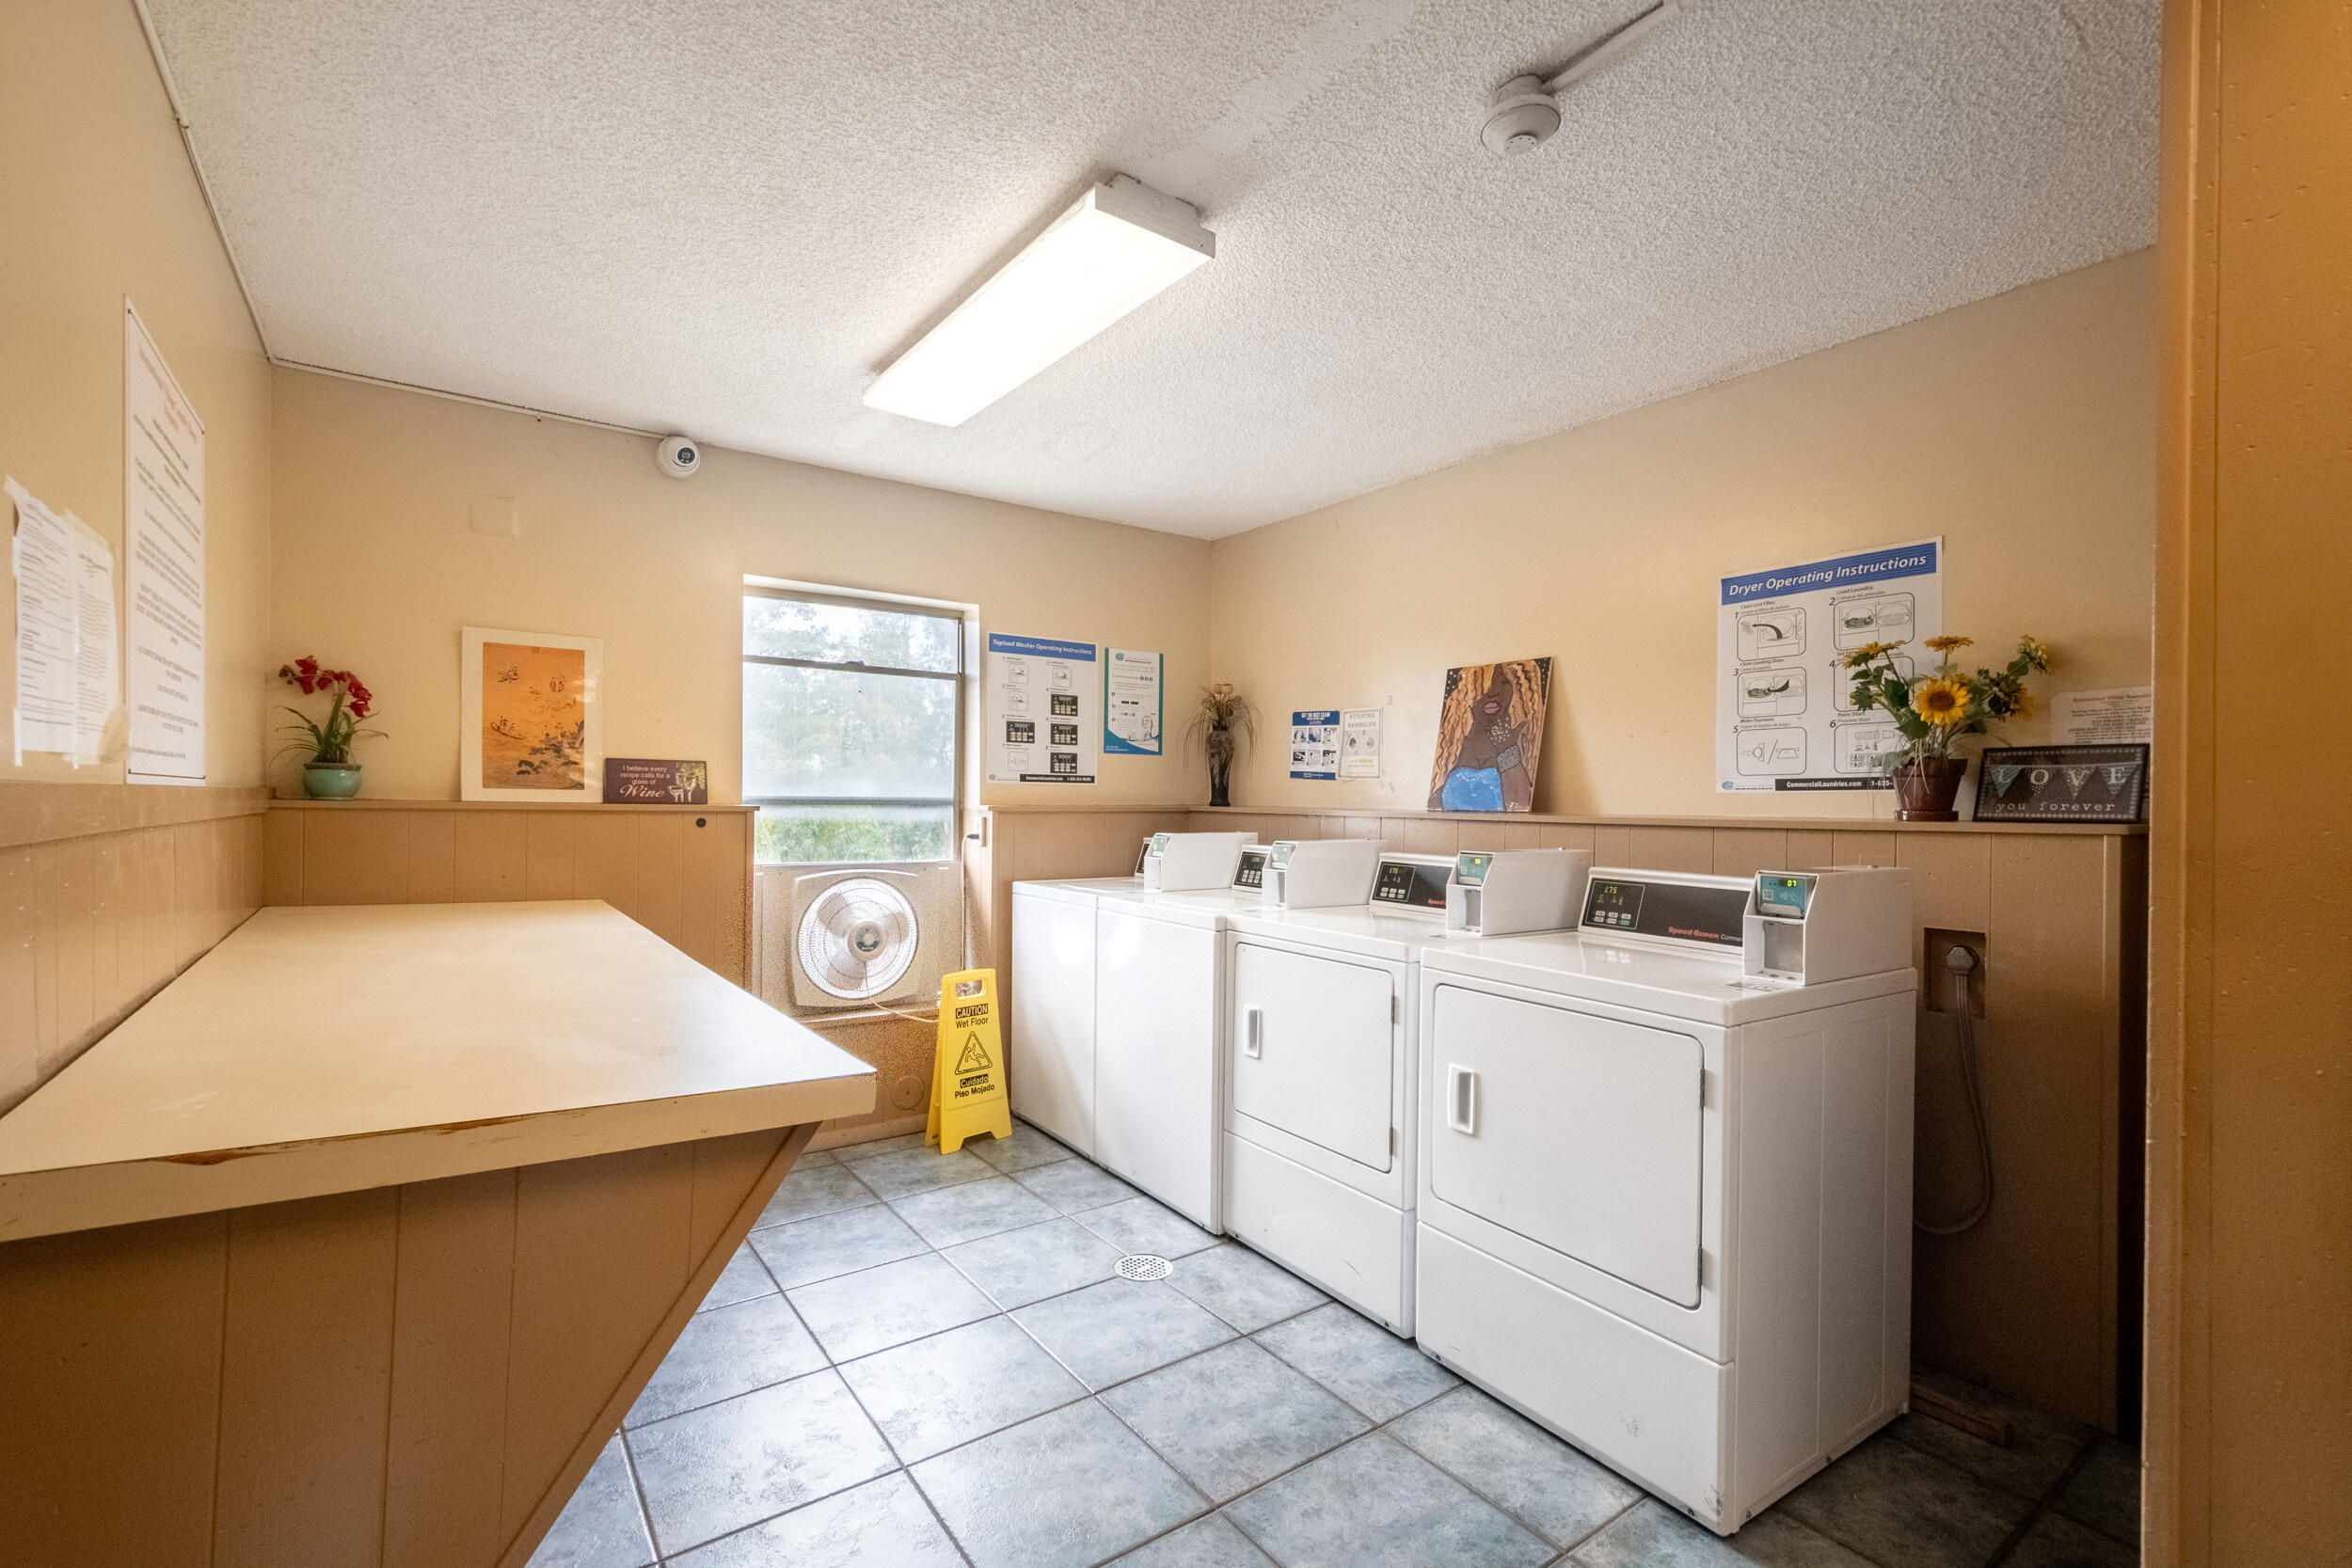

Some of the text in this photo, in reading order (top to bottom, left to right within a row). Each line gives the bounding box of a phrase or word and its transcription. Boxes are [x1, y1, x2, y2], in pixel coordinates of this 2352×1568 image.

[1729, 554, 1927, 596] Dryer Operating Instructions
[1829, 596, 1836, 606] 2
[1735, 611, 1739, 620] 1
[1036, 643, 1063, 653] Operating
[1063, 646, 1092, 655] Instructions
[1829, 659, 1836, 668] 4
[1733, 668, 1739, 676] 3
[1830, 719, 1836, 728] 6
[1733, 725, 1739, 734] 5
[1787, 780, 1862, 788] CommercialLaundries.com
[619, 784, 665, 798] Wine
[1995, 801, 2116, 813] you forever
[1668, 927, 1693, 936] Speed
[1693, 929, 1720, 939] Queen
[956, 1004, 988, 1019] CAUTION
[956, 1017, 989, 1028] Wet Floor
[961, 1075, 989, 1087] Cuidado
[955, 1084, 995, 1099] Piso Mojado
